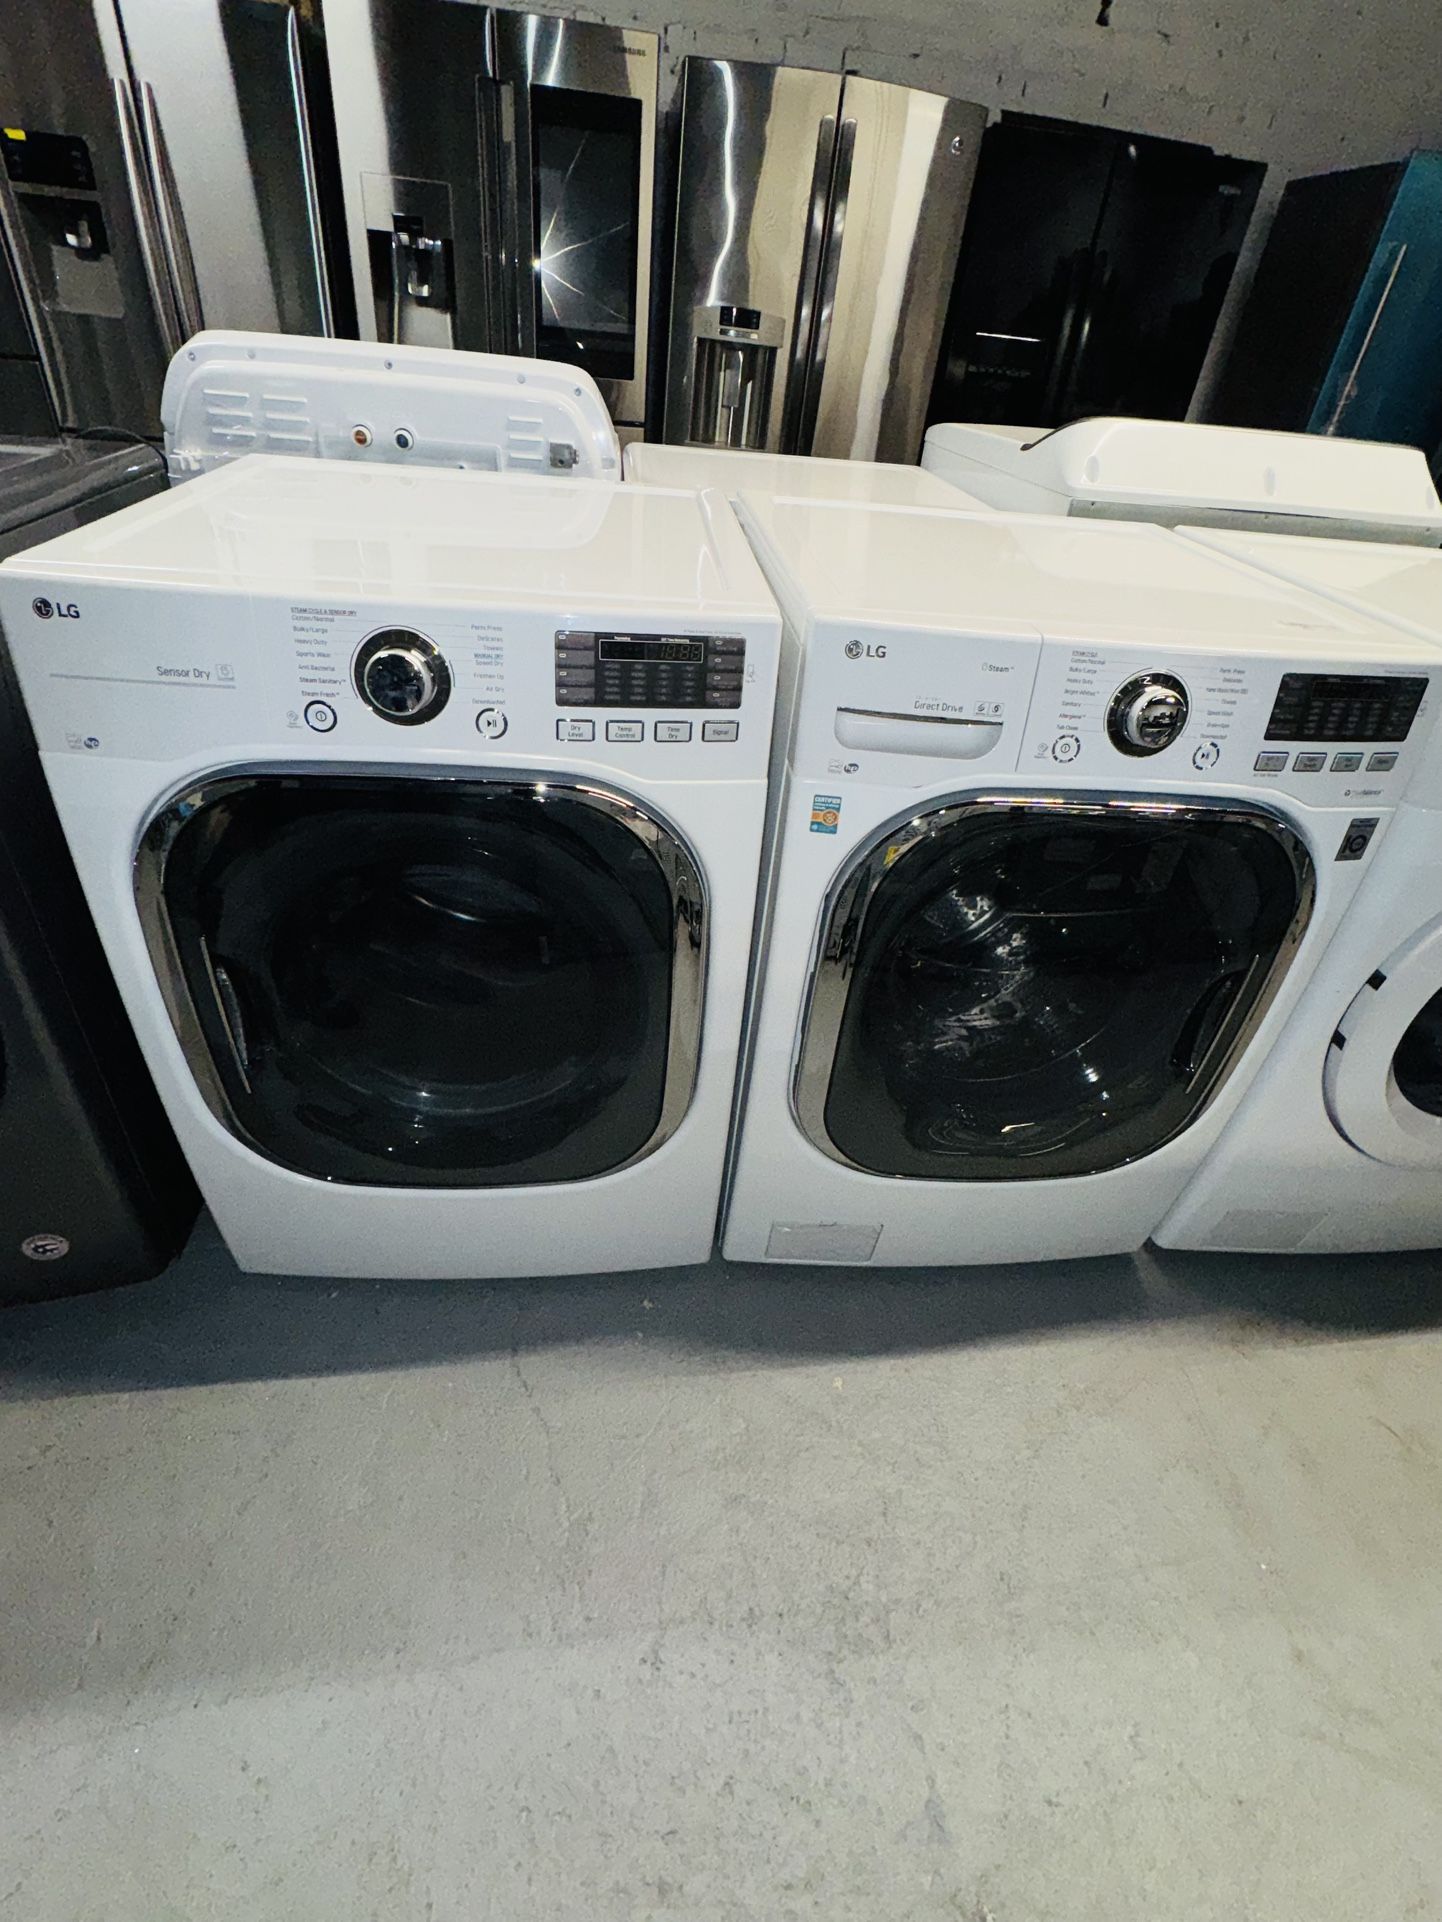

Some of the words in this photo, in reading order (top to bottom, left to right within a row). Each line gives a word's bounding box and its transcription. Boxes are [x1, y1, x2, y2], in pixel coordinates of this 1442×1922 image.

[56, 602, 80, 619] LG
[866, 644, 887, 658] LG
[156, 666, 190, 679] Sensor
[192, 668, 211, 681] Dry
[914, 700, 940, 711] Direct
[941, 702, 964, 713] Drive
[617, 725, 632, 733] Temp
